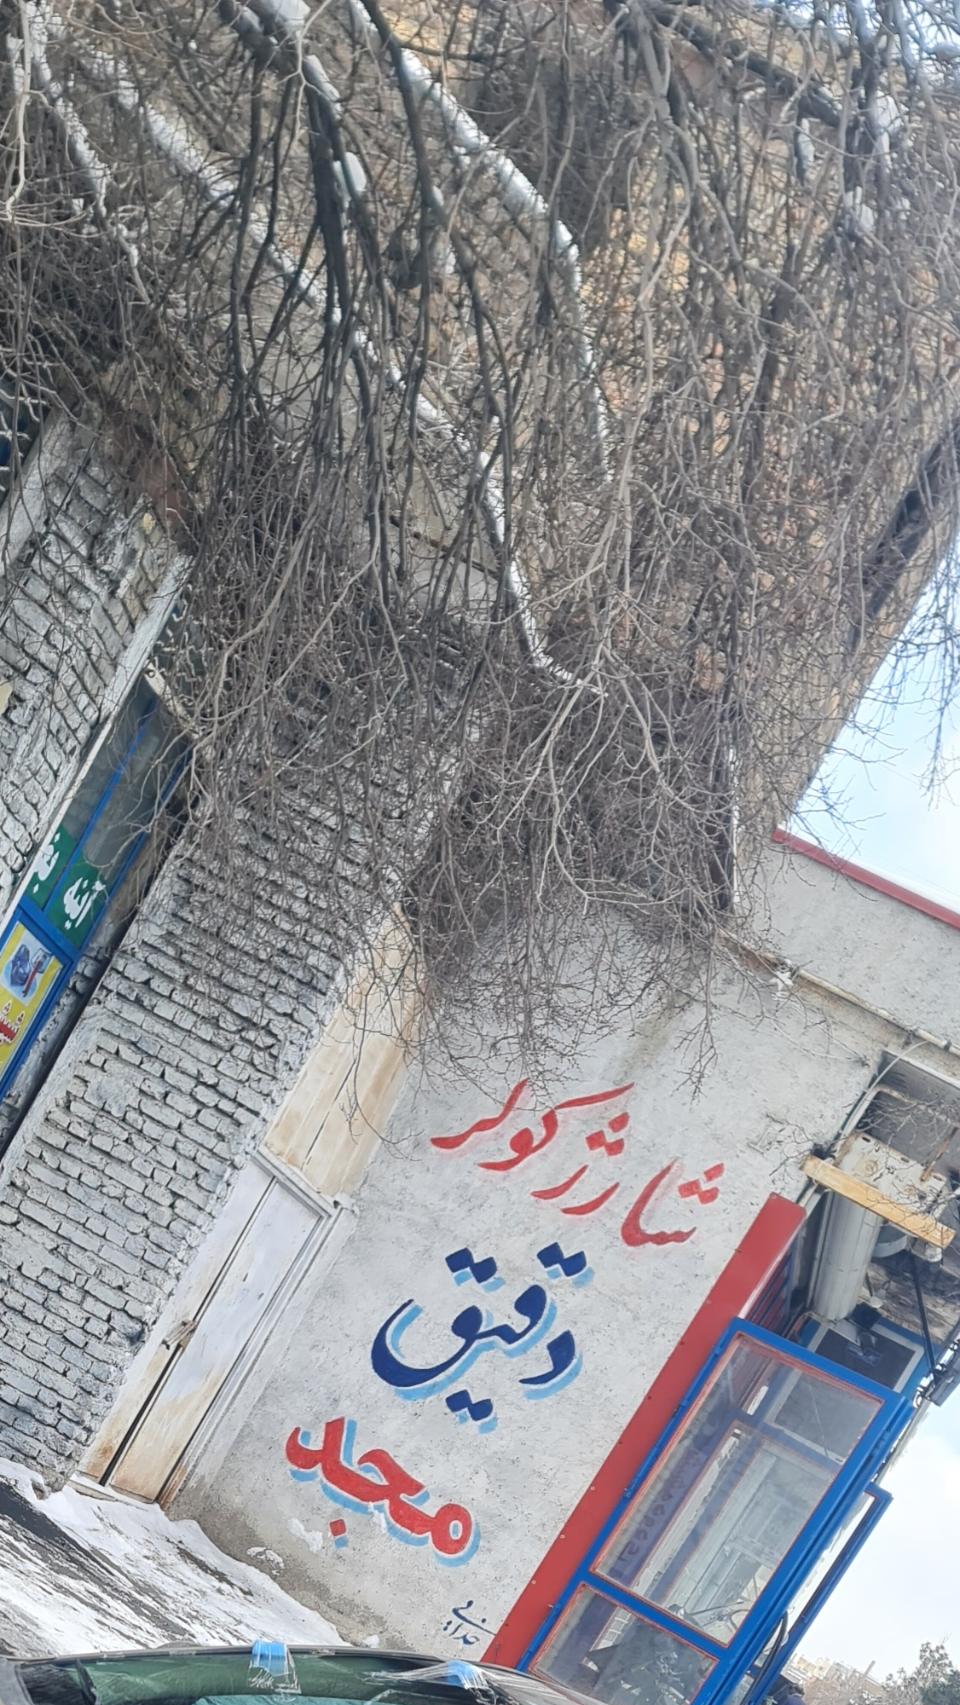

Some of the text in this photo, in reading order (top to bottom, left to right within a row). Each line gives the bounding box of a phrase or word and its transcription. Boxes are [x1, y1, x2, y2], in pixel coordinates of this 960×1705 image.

[429, 1077, 725, 1247] شارژ کولر
[370, 1242, 590, 1424] دقیق
[285, 1416, 474, 1558] مجد
